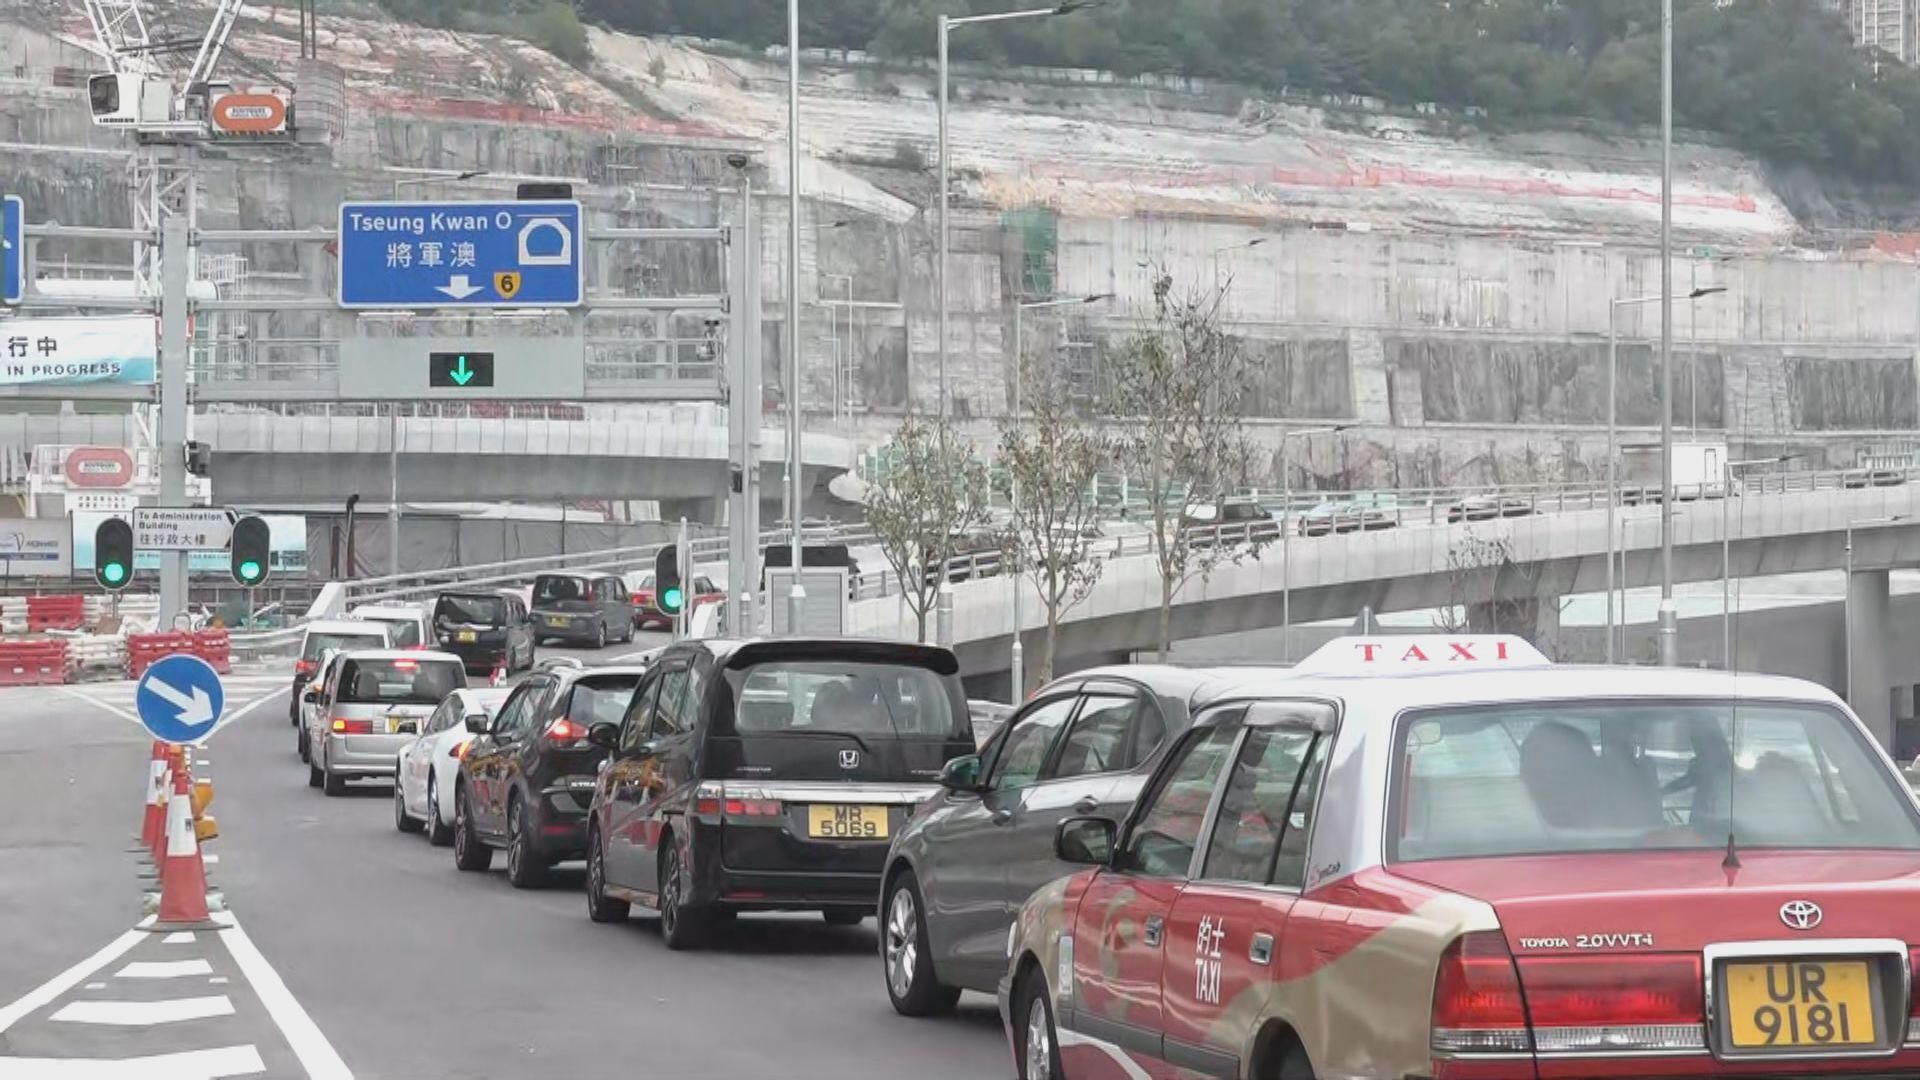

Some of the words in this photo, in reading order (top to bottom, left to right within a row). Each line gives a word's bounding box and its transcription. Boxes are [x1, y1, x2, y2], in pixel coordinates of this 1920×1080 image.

[350, 212, 425, 235] Tseung
[431, 212, 488, 230] Kwan
[495, 211, 512, 230] O
[386, 242, 476, 268] 將軍澳
[500, 274, 514, 293] 6
[0, 336, 57, 357] 行中
[7, 365, 24, 376] IN
[32, 362, 121, 376] PROGRESS
[140, 512, 150, 520] To
[153, 511, 222, 520] Administration
[139, 522, 178, 531] Building
[1355, 642, 1508, 661] TAXI
[835, 804, 862, 821] MR
[821, 820, 877, 836] 5069
[1196, 915, 1225, 958] 的士
[1519, 938, 1569, 949] TOYOTA
[1195, 957, 1222, 1005] TAXI
[1765, 964, 1828, 1003] UR
[1753, 1002, 1851, 1046] 9181
